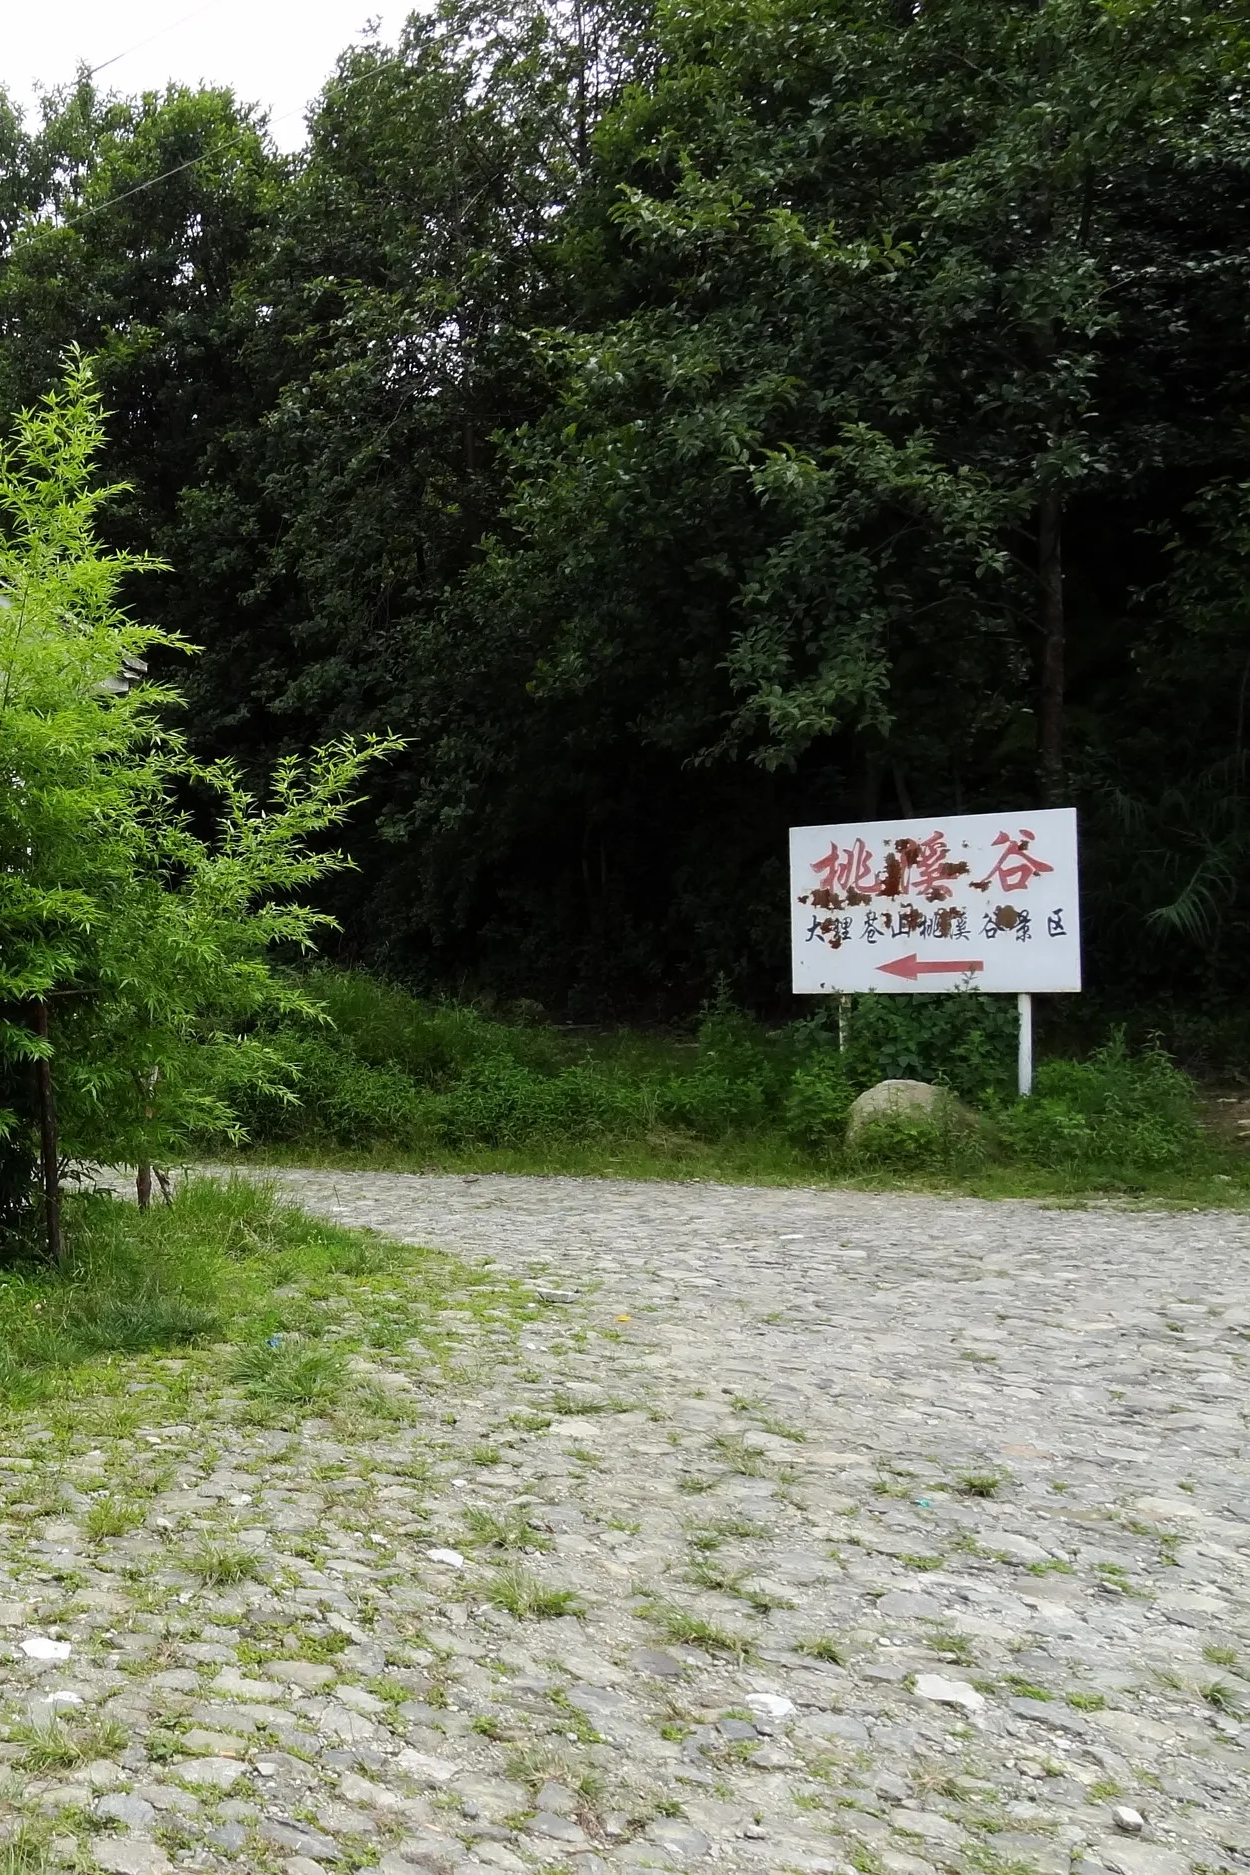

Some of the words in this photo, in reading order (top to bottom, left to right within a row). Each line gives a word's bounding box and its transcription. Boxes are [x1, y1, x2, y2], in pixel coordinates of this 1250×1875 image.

[810, 829, 1054, 898] 桃溪谷
[805, 907, 1068, 945] 大理苍山桃溪谷景区
